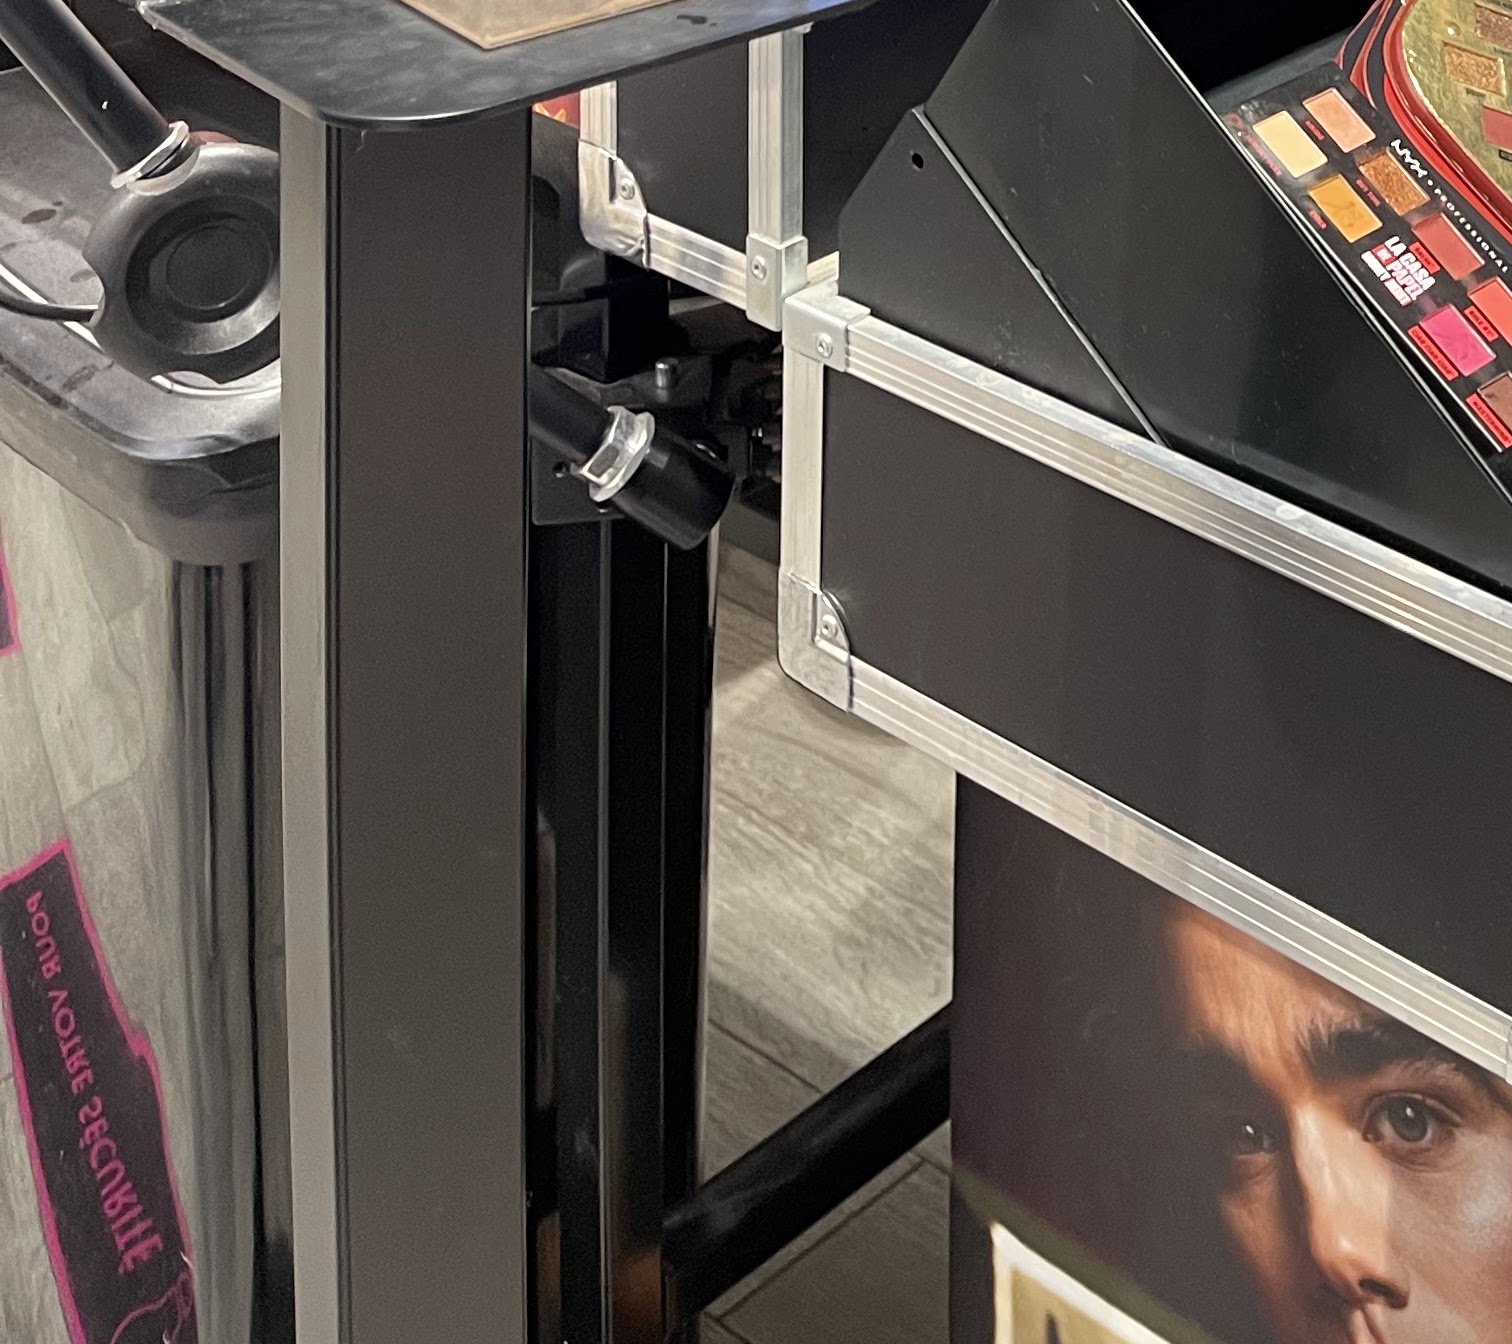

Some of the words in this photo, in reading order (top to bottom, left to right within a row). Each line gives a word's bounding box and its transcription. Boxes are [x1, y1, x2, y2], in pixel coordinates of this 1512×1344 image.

[1391, 138, 1428, 179] NYX
[1434, 187, 1509, 274] PROFESSIONAL
[1384, 235, 1407, 257] LA
[1398, 252, 1436, 291] CASA
[1386, 260, 1424, 301] PAPEL
